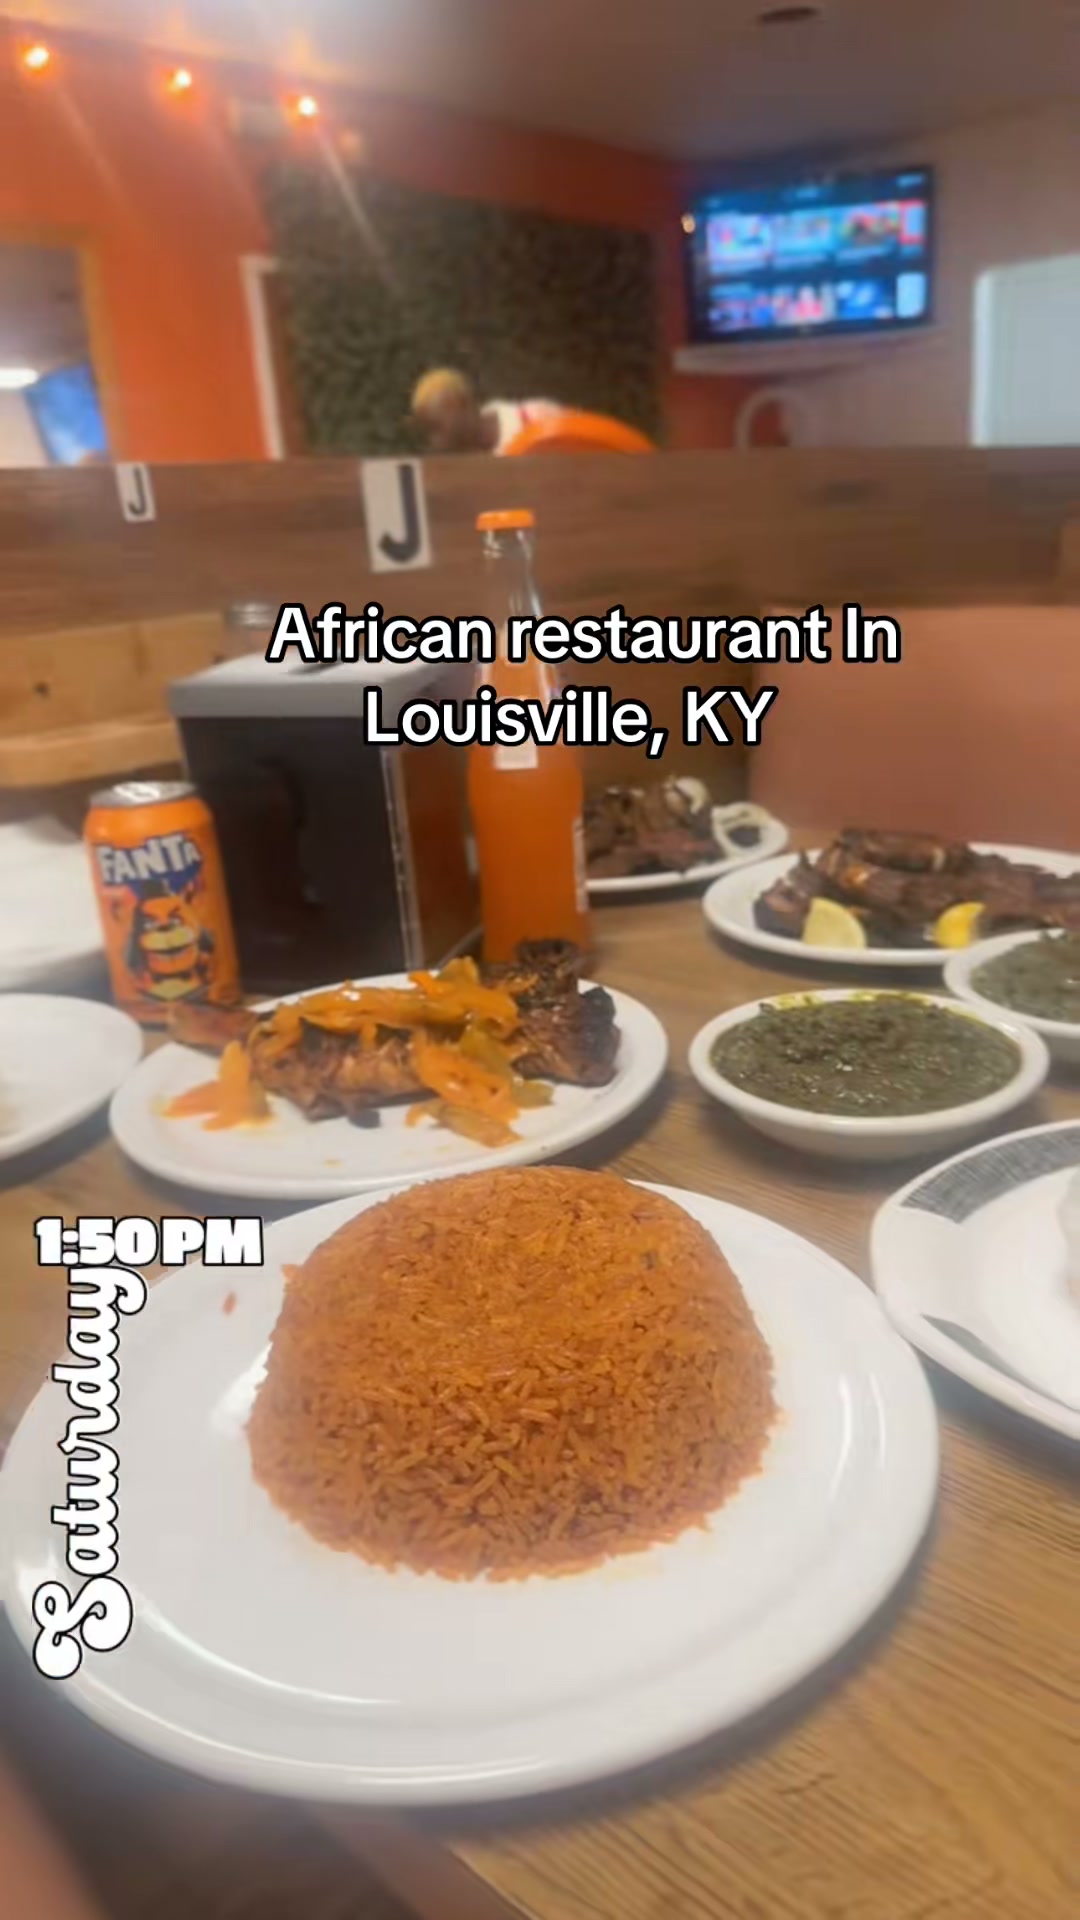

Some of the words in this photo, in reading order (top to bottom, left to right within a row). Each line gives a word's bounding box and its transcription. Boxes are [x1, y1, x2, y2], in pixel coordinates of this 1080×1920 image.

[128, 465, 147, 516] J
[379, 463, 421, 563] J
[97, 834, 201, 883] FANTA
